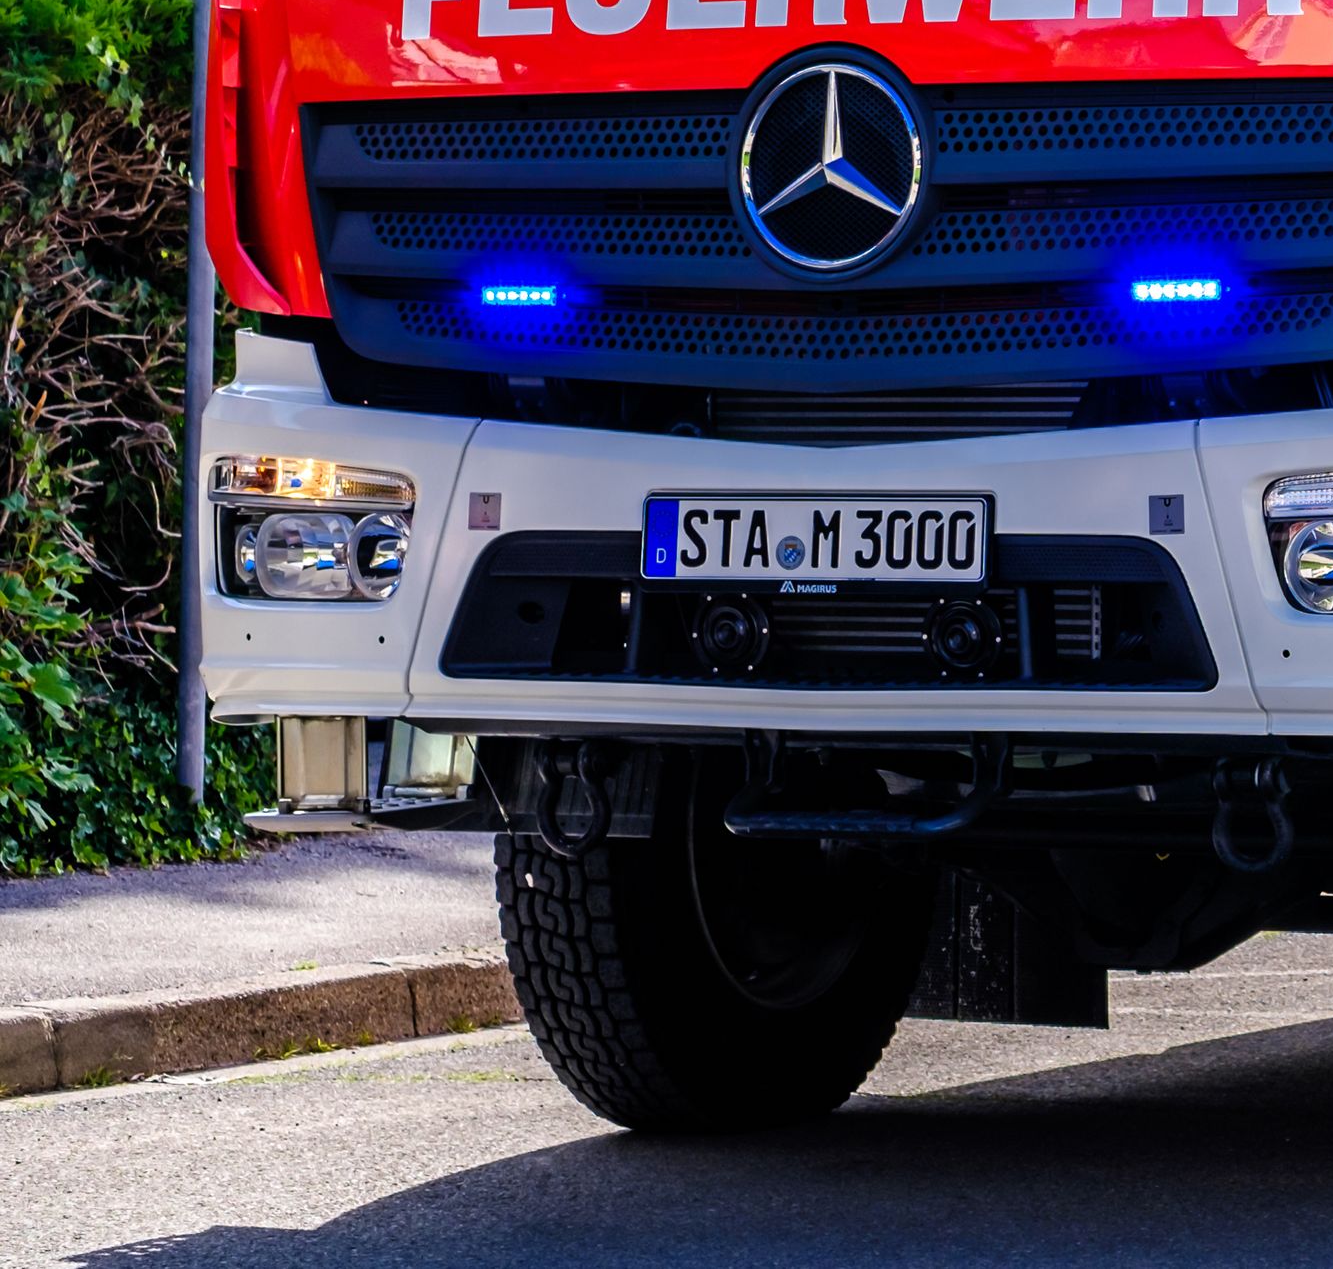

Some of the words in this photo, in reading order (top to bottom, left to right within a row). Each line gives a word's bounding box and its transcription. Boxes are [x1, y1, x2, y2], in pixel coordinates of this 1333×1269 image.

[680, 509, 770, 568] STA
[811, 509, 842, 569] M
[854, 509, 976, 570] 3000
[656, 548, 667, 564] D
[797, 584, 838, 594] MAGIRUS
